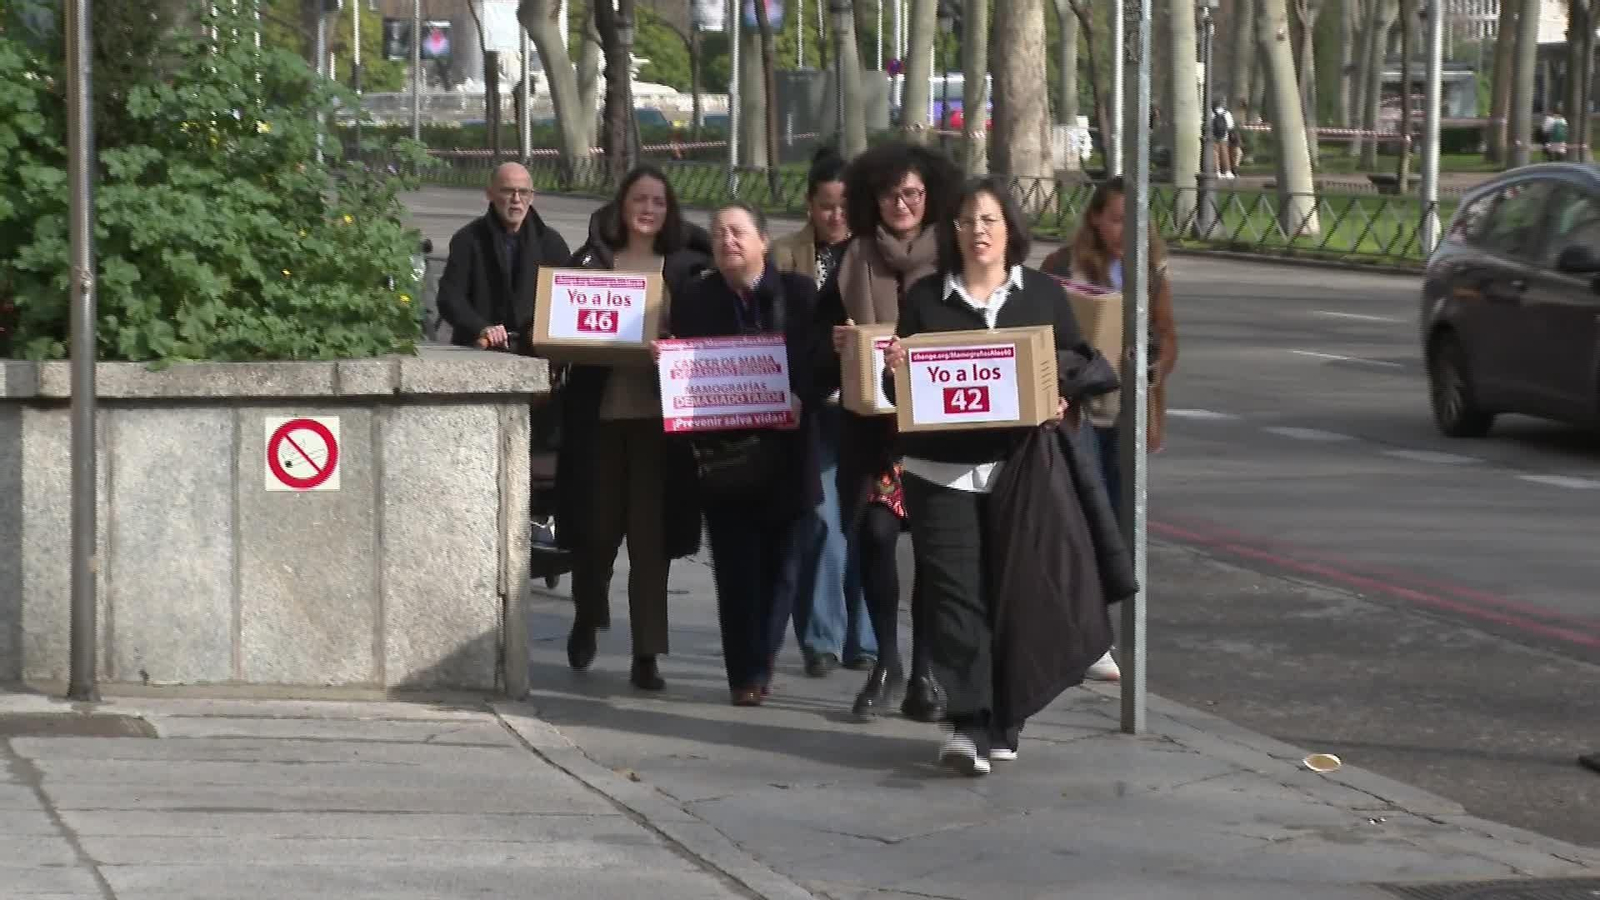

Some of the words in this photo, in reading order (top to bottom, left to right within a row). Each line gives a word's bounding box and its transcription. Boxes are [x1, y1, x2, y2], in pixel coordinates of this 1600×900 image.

[567, 289, 587, 305] Yo
[592, 294, 601, 305] a
[607, 291, 631, 307] los
[583, 311, 613, 331] 46
[927, 366, 951, 383] Yo
[956, 369, 967, 382] a
[972, 363, 1002, 381] los
[951, 388, 983, 411] 42
[672, 415, 721, 431] ¡Prevenir
[724, 413, 752, 426] salva
[754, 411, 787, 425] vidas!
